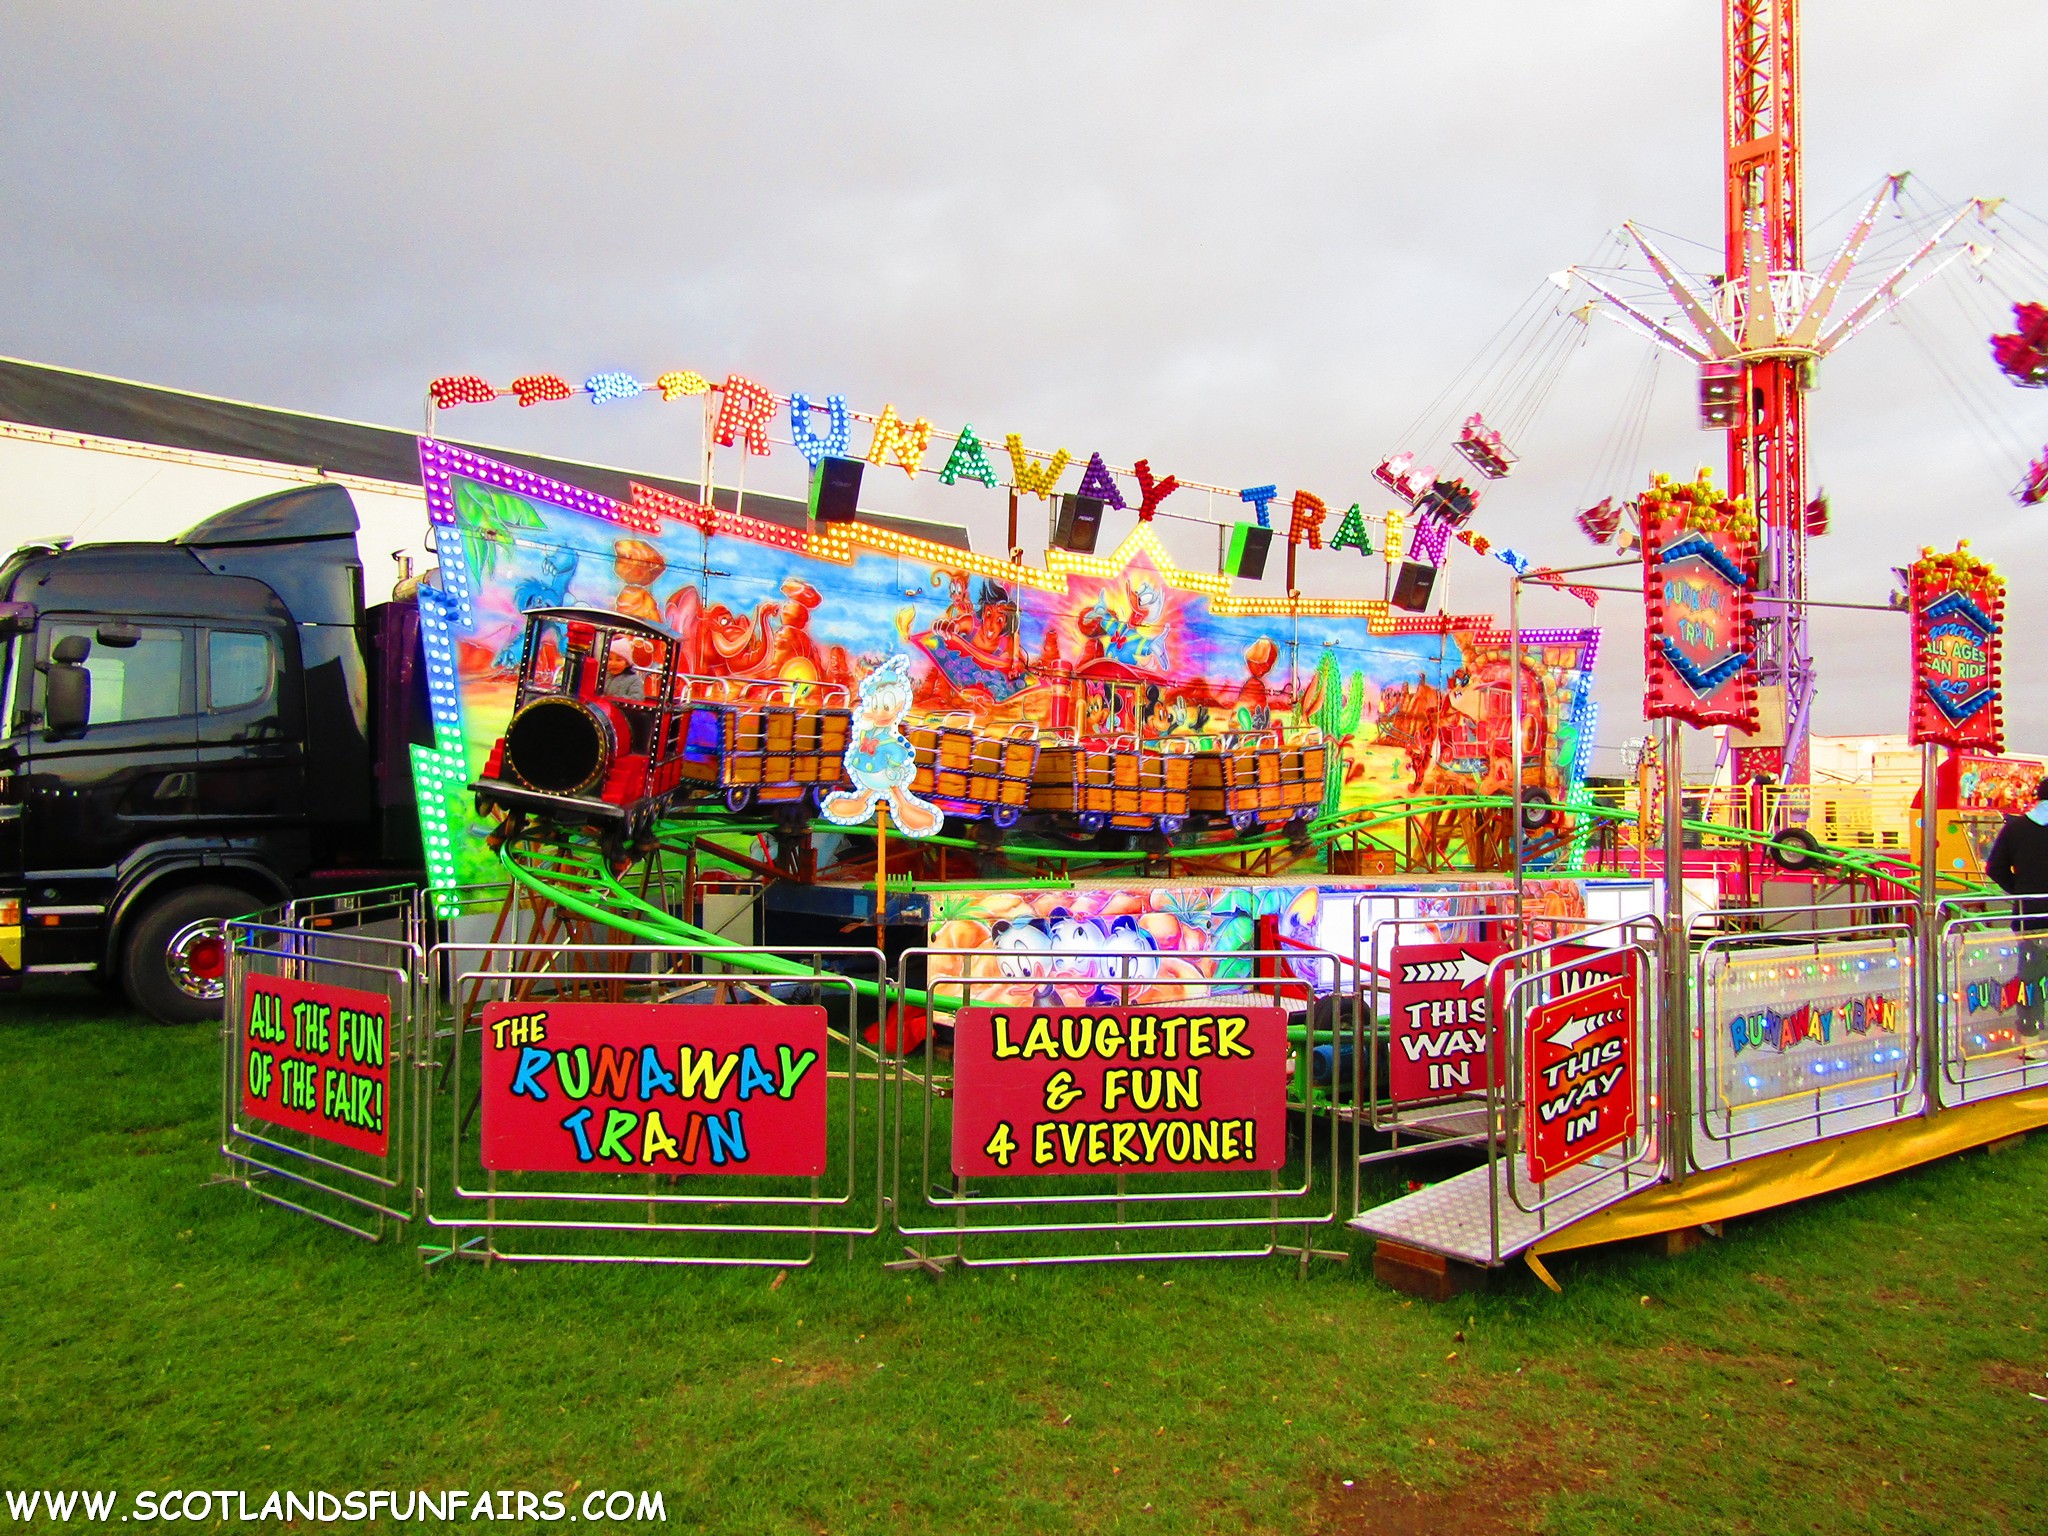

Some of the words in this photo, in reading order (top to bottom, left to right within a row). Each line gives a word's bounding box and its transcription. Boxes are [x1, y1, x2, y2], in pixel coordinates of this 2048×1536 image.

[714, 373, 1180, 521] RUNAWAY
[1240, 484, 1454, 570] TRAIN
[1664, 580, 1726, 616] RUNAWAY
[1678, 618, 1715, 651] TRAIN
[1952, 642, 1987, 663] AGES
[1940, 679, 1970, 695] OLD
[1957, 661, 1987, 679] RIDE
[1404, 996, 1488, 1030] THIS
[1967, 977, 2034, 1015] RUNAWAY
[249, 992, 286, 1044] ALL
[292, 1000, 331, 1056] THE
[338, 1010, 385, 1067] FUN
[492, 1012, 548, 1050] THE
[991, 1014, 1254, 1062] LAUGHTER
[1400, 1026, 1497, 1062] WAY
[1729, 1000, 1834, 1055] RUNAWAY
[1841, 993, 1897, 1036] TRAIN
[510, 1045, 818, 1102] RUNAWAY
[1427, 1060, 1471, 1090] IN
[1543, 1038, 1624, 1090] THIS
[248, 1050, 272, 1099] OF
[279, 1057, 318, 1115] THE
[324, 1068, 384, 1132] FAIR!
[1043, 1068, 1084, 1114] &
[1103, 1066, 1202, 1113] FUN
[1538, 1064, 1626, 1122] WAY
[560, 1108, 750, 1166] TRAIN
[984, 1121, 1018, 1168] 4
[1033, 1119, 1257, 1167] EVERYONE!
[1565, 1108, 1600, 1145] IN
